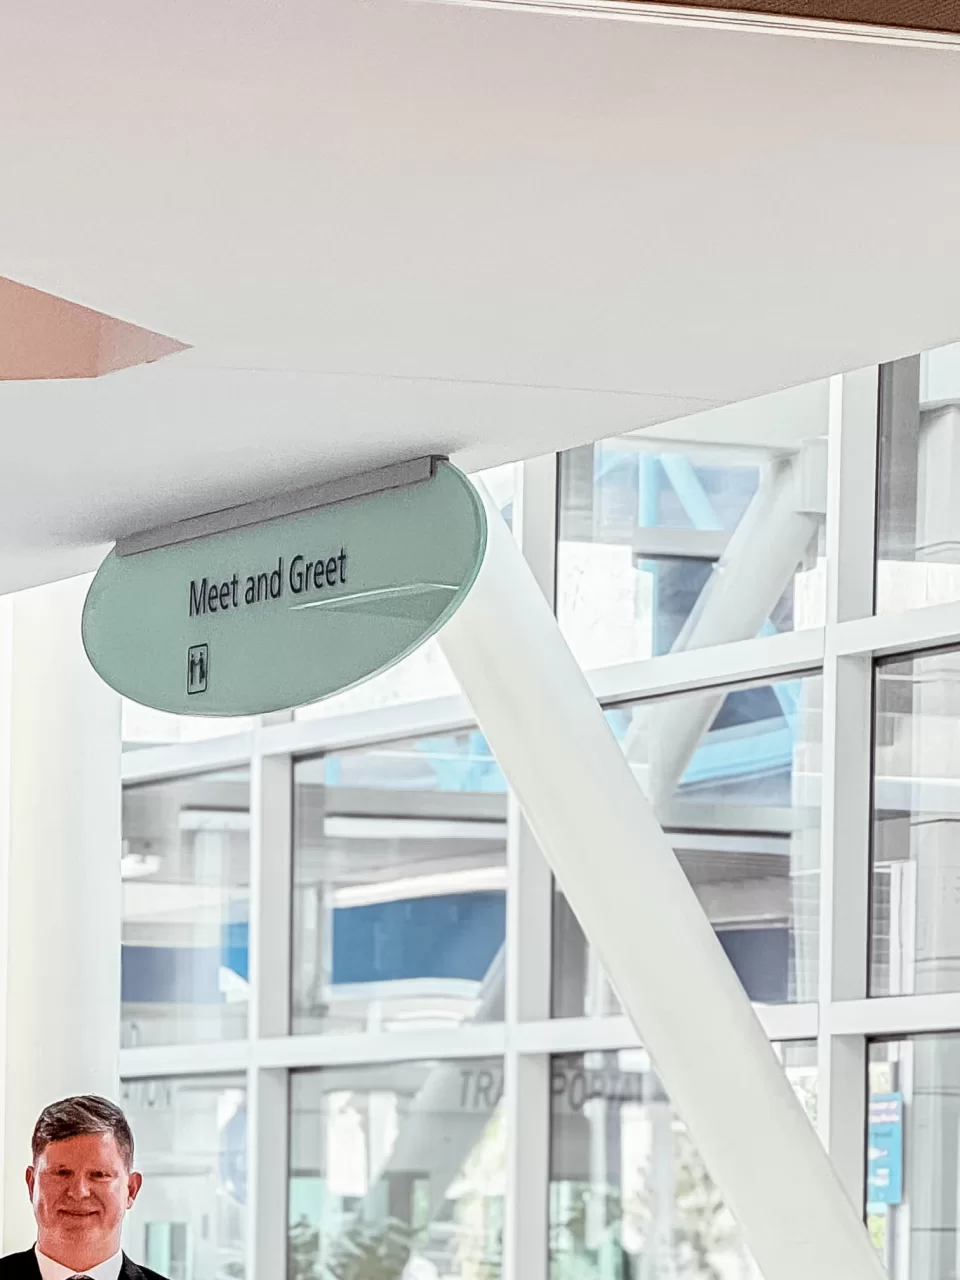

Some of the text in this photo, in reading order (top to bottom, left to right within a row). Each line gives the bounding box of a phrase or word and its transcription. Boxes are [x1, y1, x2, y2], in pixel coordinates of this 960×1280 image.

[189, 547, 347, 617] Meet and Greet
